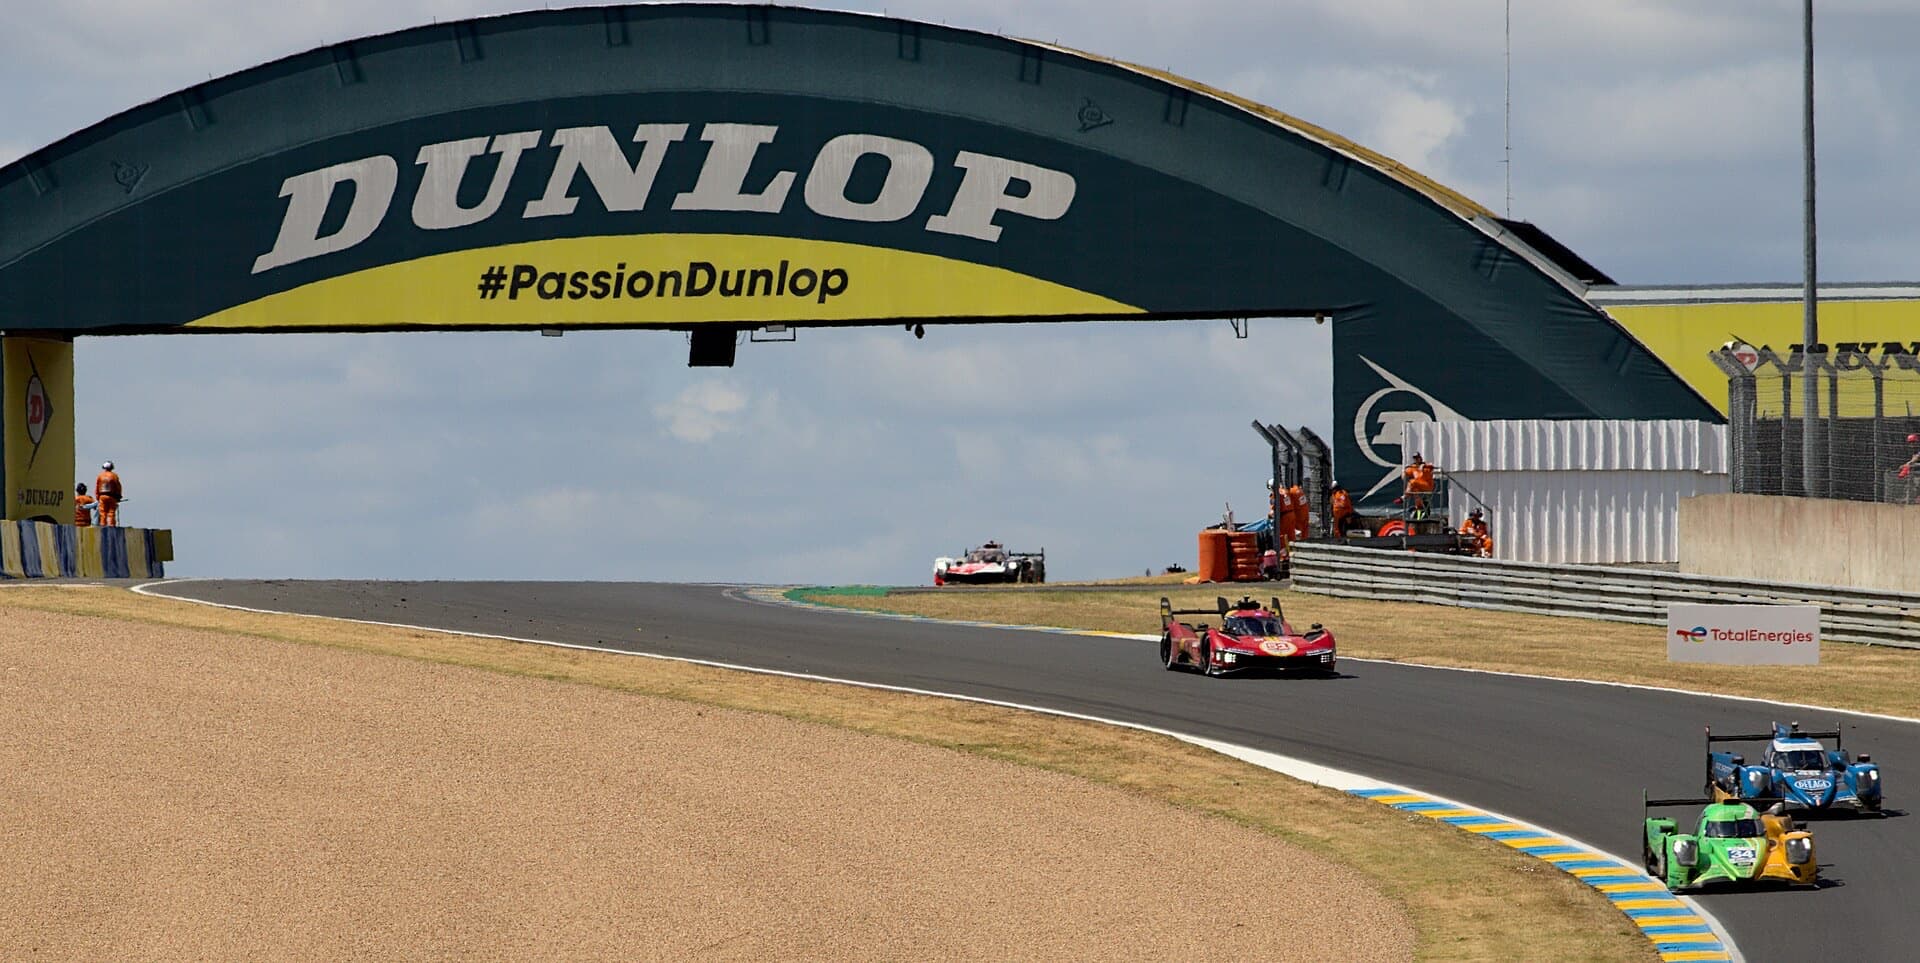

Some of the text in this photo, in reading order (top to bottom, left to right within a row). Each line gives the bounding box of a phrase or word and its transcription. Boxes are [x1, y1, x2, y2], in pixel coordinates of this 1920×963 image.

[250, 122, 1077, 274] DUNLOP
[477, 261, 850, 304] #PassionDunlop
[25, 488, 64, 506] DUNLOP
[1711, 628, 1814, 645] TotalEnergies
[1730, 849, 1754, 859] 34
